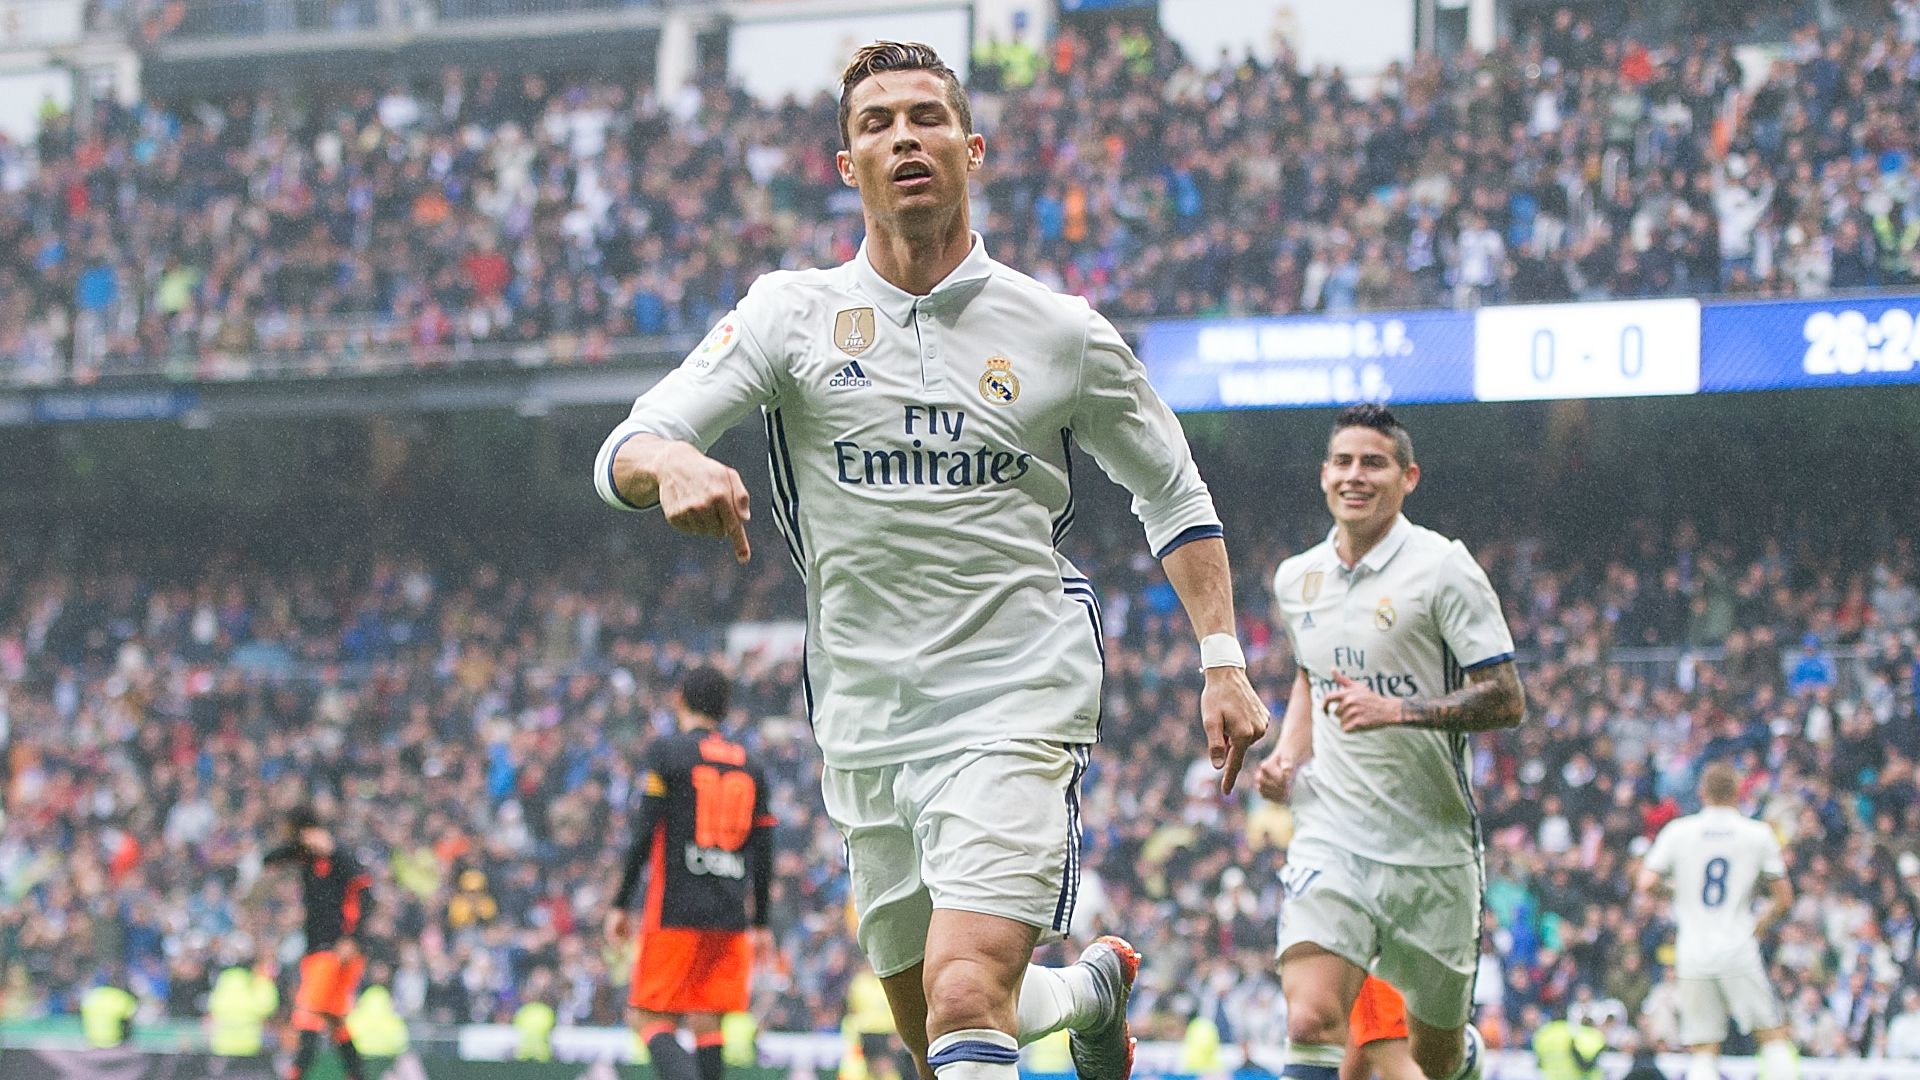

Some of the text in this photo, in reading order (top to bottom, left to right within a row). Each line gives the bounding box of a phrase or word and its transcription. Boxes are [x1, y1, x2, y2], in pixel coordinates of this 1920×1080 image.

[1532, 328, 1555, 382] 0
[1621, 324, 1643, 378] 0
[829, 376, 872, 387] adidas
[904, 405, 965, 442] Fly
[834, 439, 1032, 486] Emirates
[1334, 647, 1365, 671] Fly
[691, 764, 756, 852] 10
[1703, 857, 1729, 907] 8
